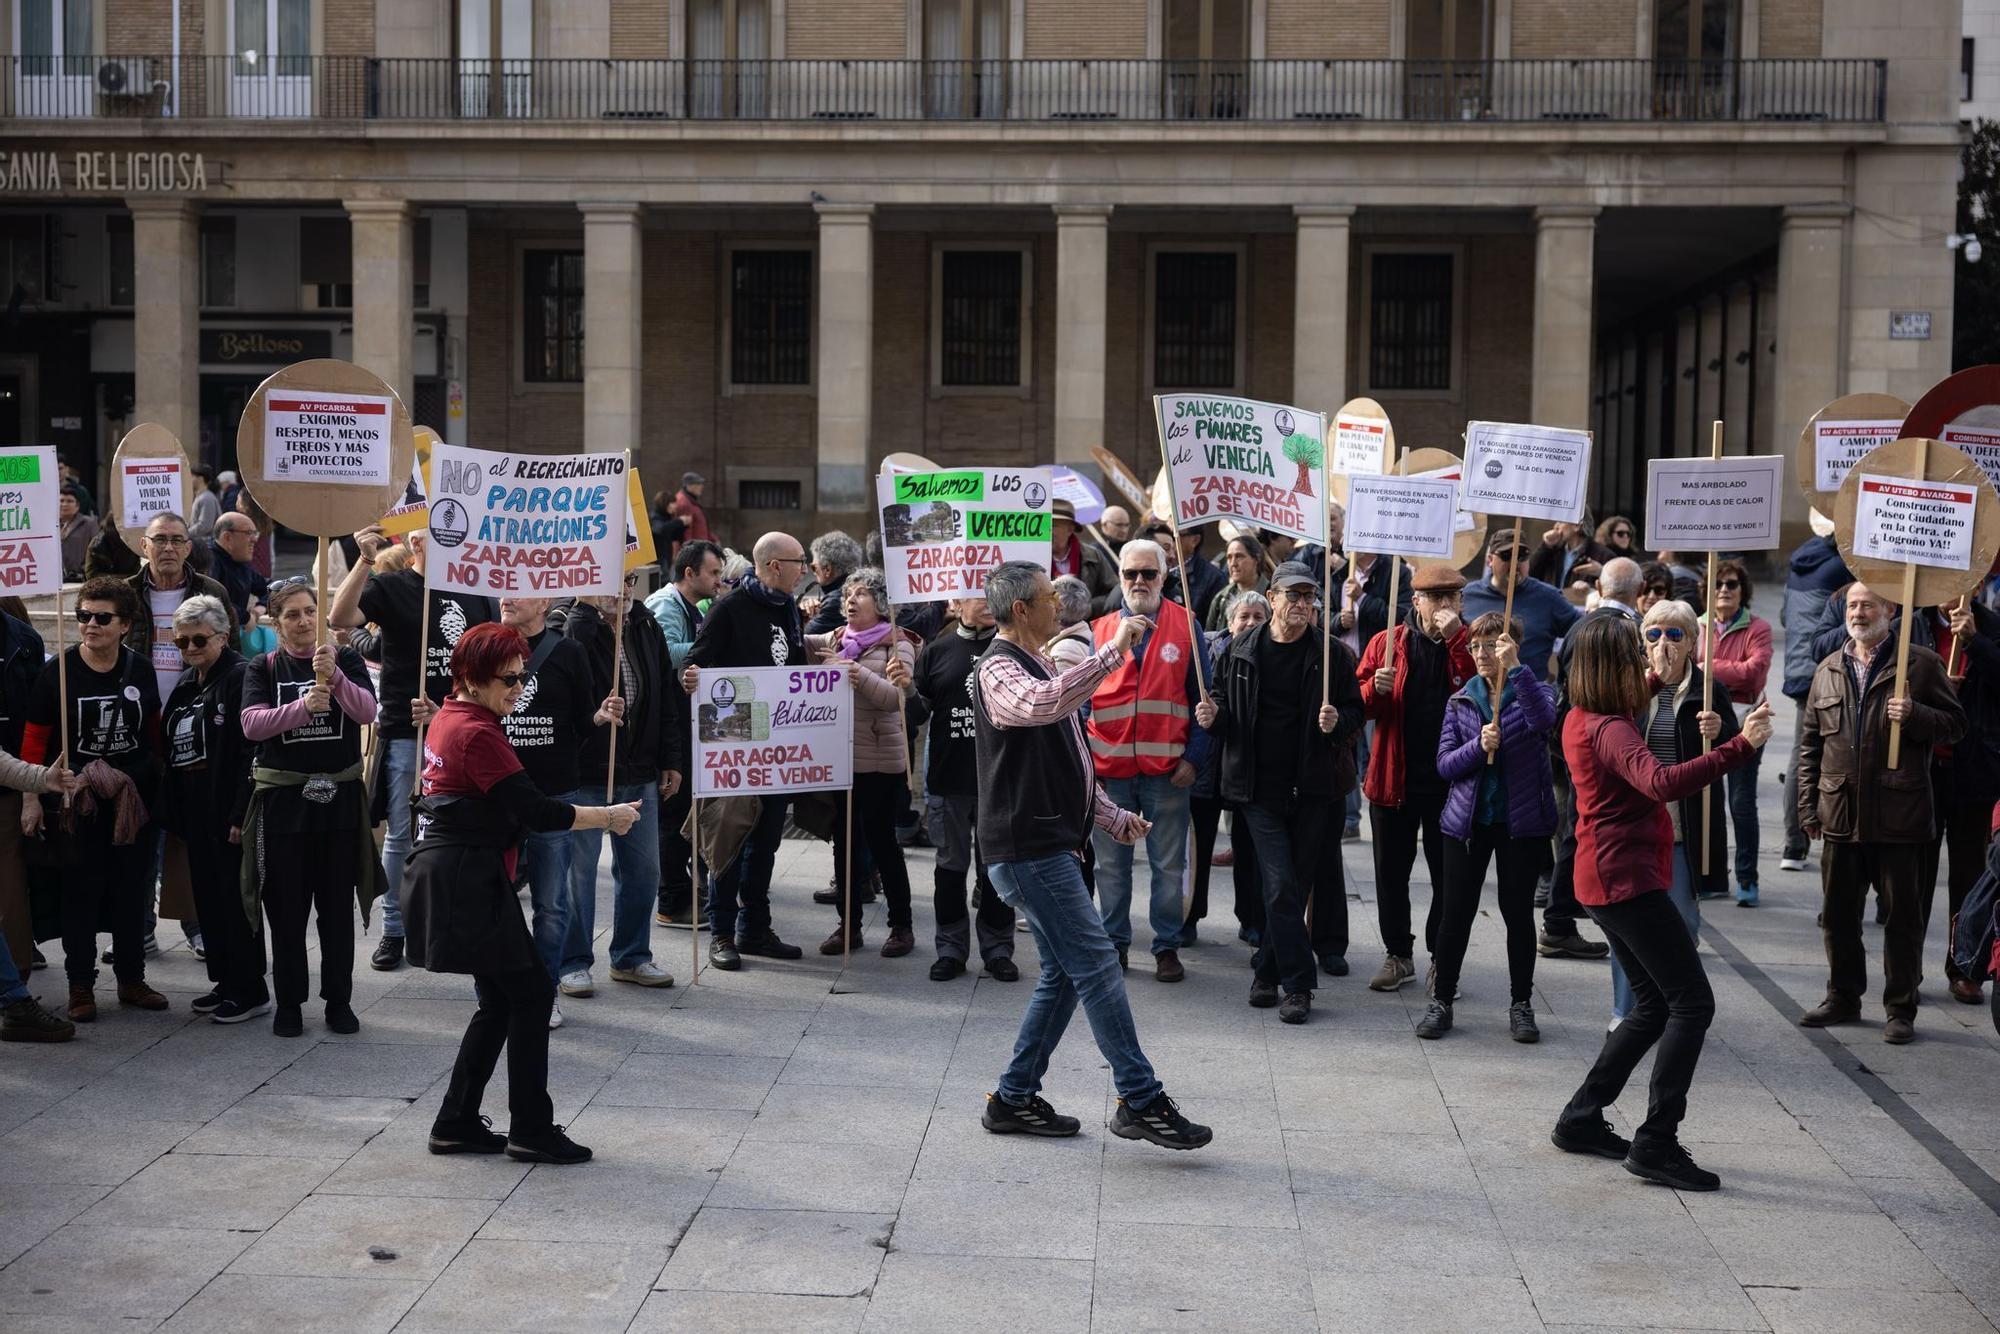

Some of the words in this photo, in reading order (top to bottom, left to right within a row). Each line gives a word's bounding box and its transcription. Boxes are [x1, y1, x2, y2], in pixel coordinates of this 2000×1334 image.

[76, 152, 207, 191] RELIGIOSA
[218, 333, 304, 359] Belloso
[314, 404, 356, 412] PICARRAL
[1174, 400, 1255, 422] SALVEMOS
[299, 414, 357, 426] EXIGIMOS
[276, 427, 334, 440] RESPETO,
[338, 429, 379, 440] MENOS
[1168, 421, 1189, 440] los
[1195, 418, 1263, 446] PINARES
[1953, 434, 1990, 444] COMISIÓN
[334, 443, 342, 452] Y
[346, 441, 370, 453] MÁS
[1840, 436, 1876, 446] CAMPO
[1506, 450, 1534, 458] PINARES
[1544, 453, 1572, 462] VENECIA
[1532, 445, 1576, 456] ZARAGOZANOS
[292, 454, 363, 466] PROYECTOS
[1172, 445, 1193, 466] de
[1204, 444, 1275, 478] VENECIA
[136, 475, 161, 486] FONDO
[162, 474, 172, 484] DE
[308, 469, 361, 477] CINCOMARZADA
[440, 459, 482, 496] NO
[488, 456, 510, 477] al
[139, 487, 171, 498] VIVIENDA
[900, 474, 980, 500] Salvemos
[991, 474, 1022, 492] LOS
[1370, 488, 1412, 497] INVERSIONES
[1701, 480, 1748, 489] ARBOLADO
[486, 484, 610, 513] PARQUE
[1191, 476, 1300, 511] ZARAGOZA
[1376, 496, 1425, 505] DEPURADORAS
[1478, 490, 1516, 500] ZARAGOZA
[1538, 497, 1562, 506] VENDE
[1736, 497, 1764, 505] CALOR
[1878, 485, 1890, 493] AV
[1892, 487, 1918, 497] UTEBO
[1920, 490, 1956, 501] AVANZA
[1181, 496, 1210, 520] NO
[1216, 494, 1244, 516] SE
[1247, 500, 1306, 532] VENDE
[1886, 498, 1956, 514] Construcción
[1875, 508, 1905, 520] Paseo
[1908, 512, 1965, 528] Ciudadano
[478, 514, 608, 545] ATRACCIONES
[1358, 532, 1392, 540] ZARAGOZA
[1880, 522, 1892, 530] en
[1896, 522, 1904, 532] la
[1908, 525, 1940, 537] Crtra.
[1944, 528, 1956, 539] de
[1882, 533, 1926, 547] Logroño
[1929, 539, 1951, 550] YA!!
[460, 542, 596, 569] ZARAGOZA
[906, 545, 1004, 570] ZARAGOZA
[1892, 548, 1943, 560] CINCOMARZADA
[446, 562, 480, 588] NO
[488, 568, 520, 591] SE
[528, 566, 602, 591] VENDE
[908, 572, 933, 595] NO
[936, 570, 959, 592] SE
[788, 670, 842, 694] STOP
[316, 718, 325, 726] LA
[500, 714, 553, 725] alvemos
[950, 720, 962, 728] los
[506, 725, 554, 736] Pinares
[704, 744, 814, 769] ZARAGOZA
[714, 768, 742, 789] NO
[746, 767, 773, 787] SE
[778, 766, 834, 786] VENDE
